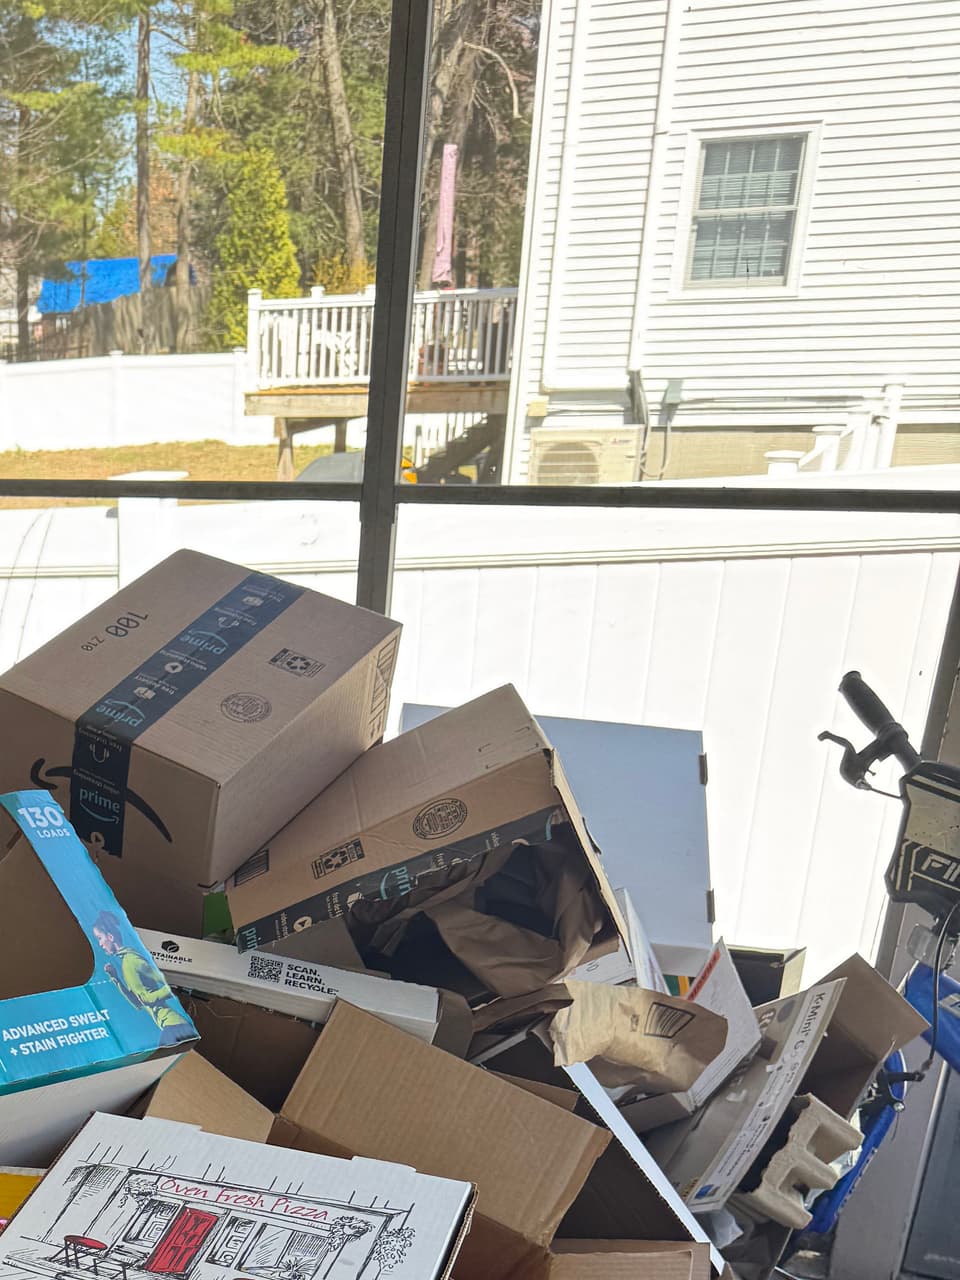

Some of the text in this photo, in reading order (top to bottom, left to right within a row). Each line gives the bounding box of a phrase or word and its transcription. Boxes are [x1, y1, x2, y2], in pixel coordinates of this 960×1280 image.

[105, 611, 149, 638] 100
[179, 634, 227, 656] prime
[95, 704, 143, 728] prime
[80, 788, 121, 813] prime
[18, 806, 64, 828] 130
[36, 829, 71, 839] LOADS
[150, 951, 192, 963] STAINABLE
[286, 971, 325, 986] LEARN.
[287, 964, 320, 977] SCAN.
[1, 1009, 110, 1042] ADVANCED SWEAT
[20, 1038, 57, 1057] STAIN
[59, 1027, 110, 1048] FIGHTER
[159, 1177, 329, 1220] Oven Fresh Pizza
